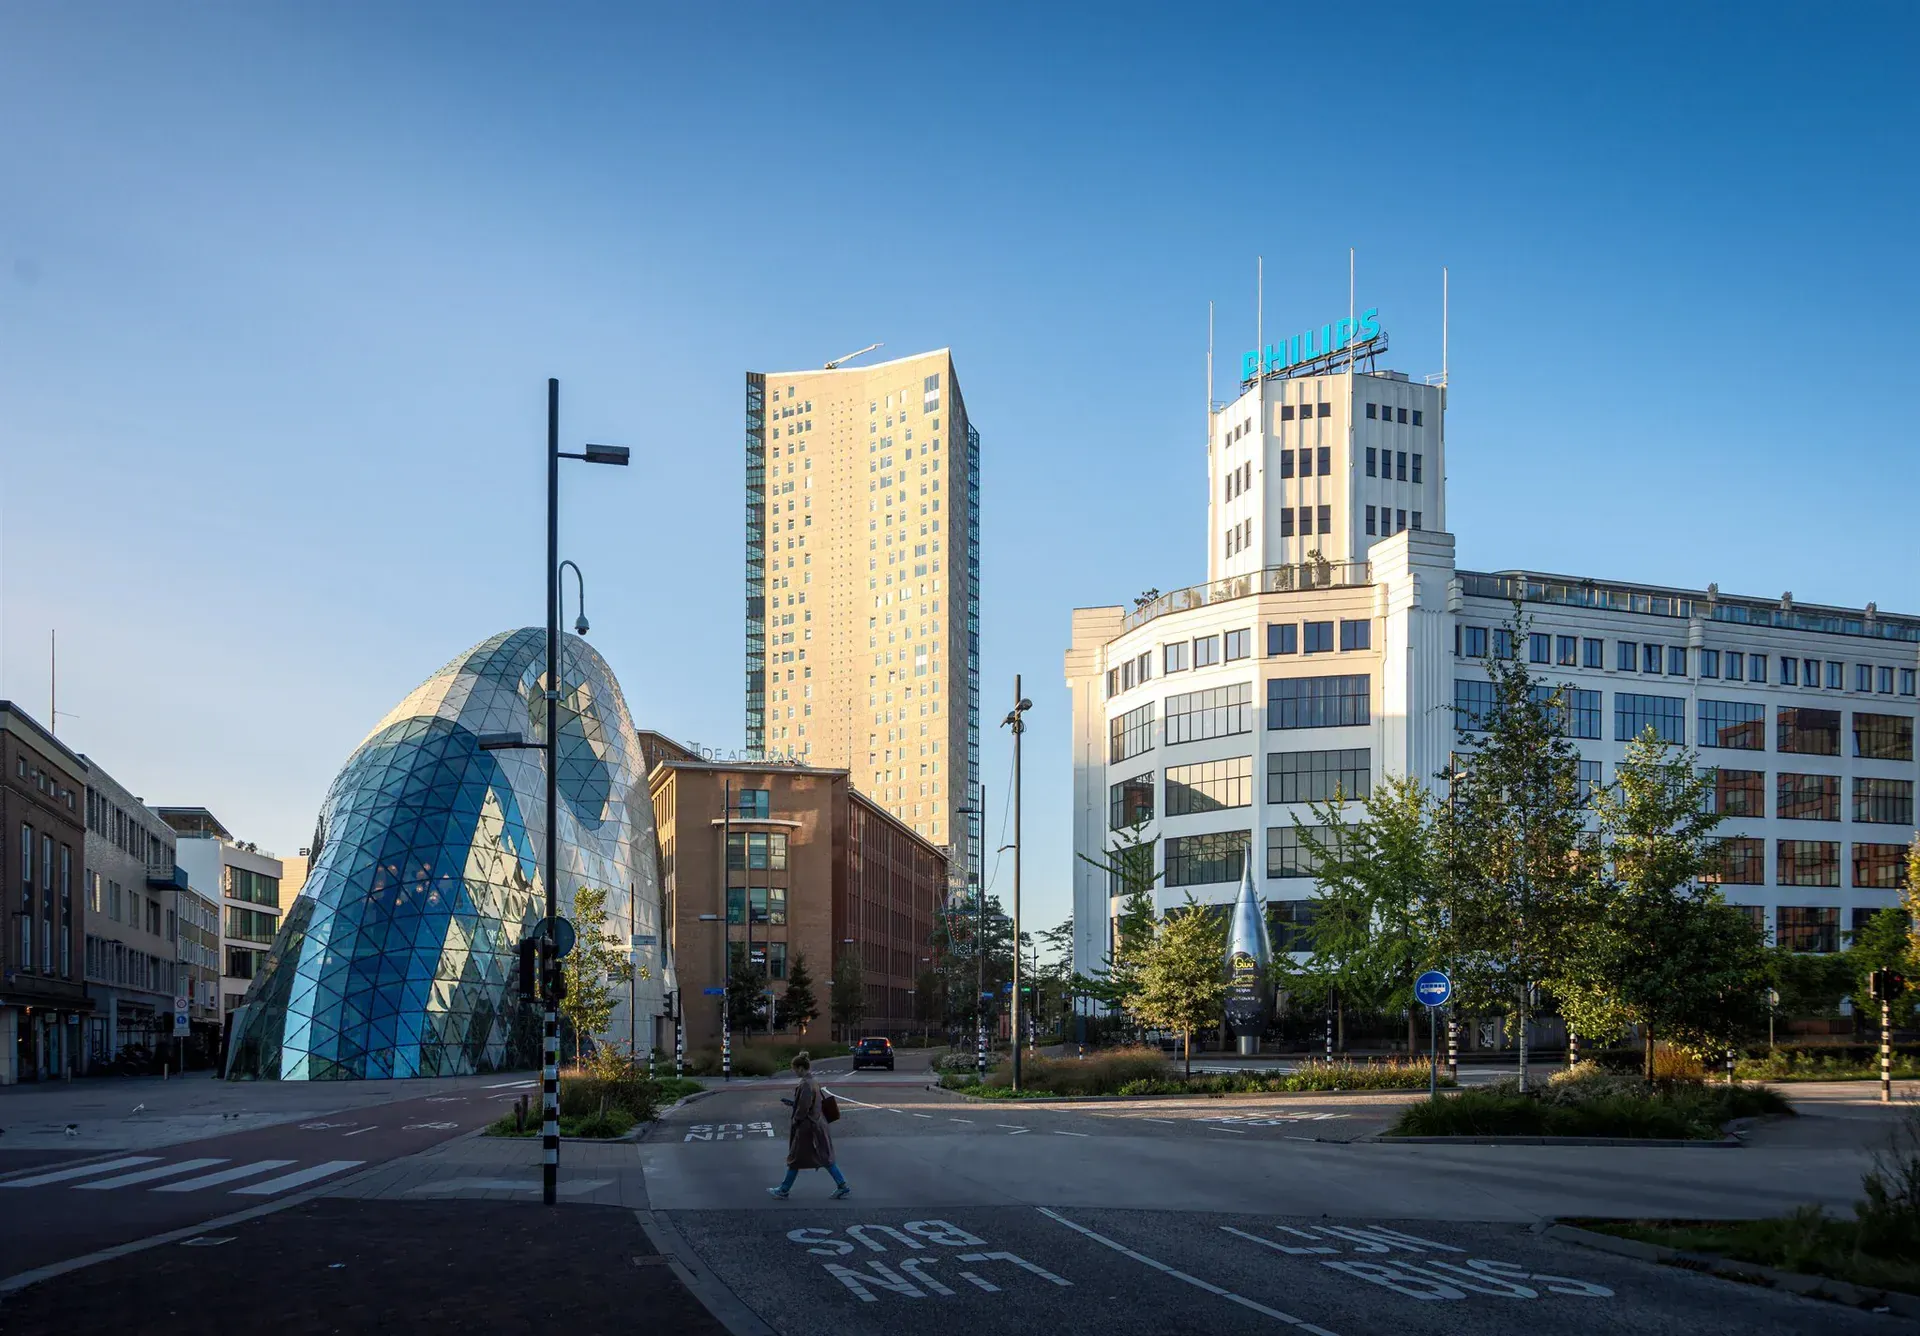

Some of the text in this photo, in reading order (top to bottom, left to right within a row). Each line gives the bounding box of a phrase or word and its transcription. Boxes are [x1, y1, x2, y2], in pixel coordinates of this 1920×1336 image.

[1241, 307, 1381, 382] PHILIPS
[703, 748, 806, 764] DE ADRANT
[689, 1122, 773, 1133] BUS
[786, 1219, 988, 1256] BUS
[1218, 1225, 1467, 1254] LIJN
[822, 1251, 1074, 1301] LIJN
[1320, 1258, 1615, 1300] BUS
